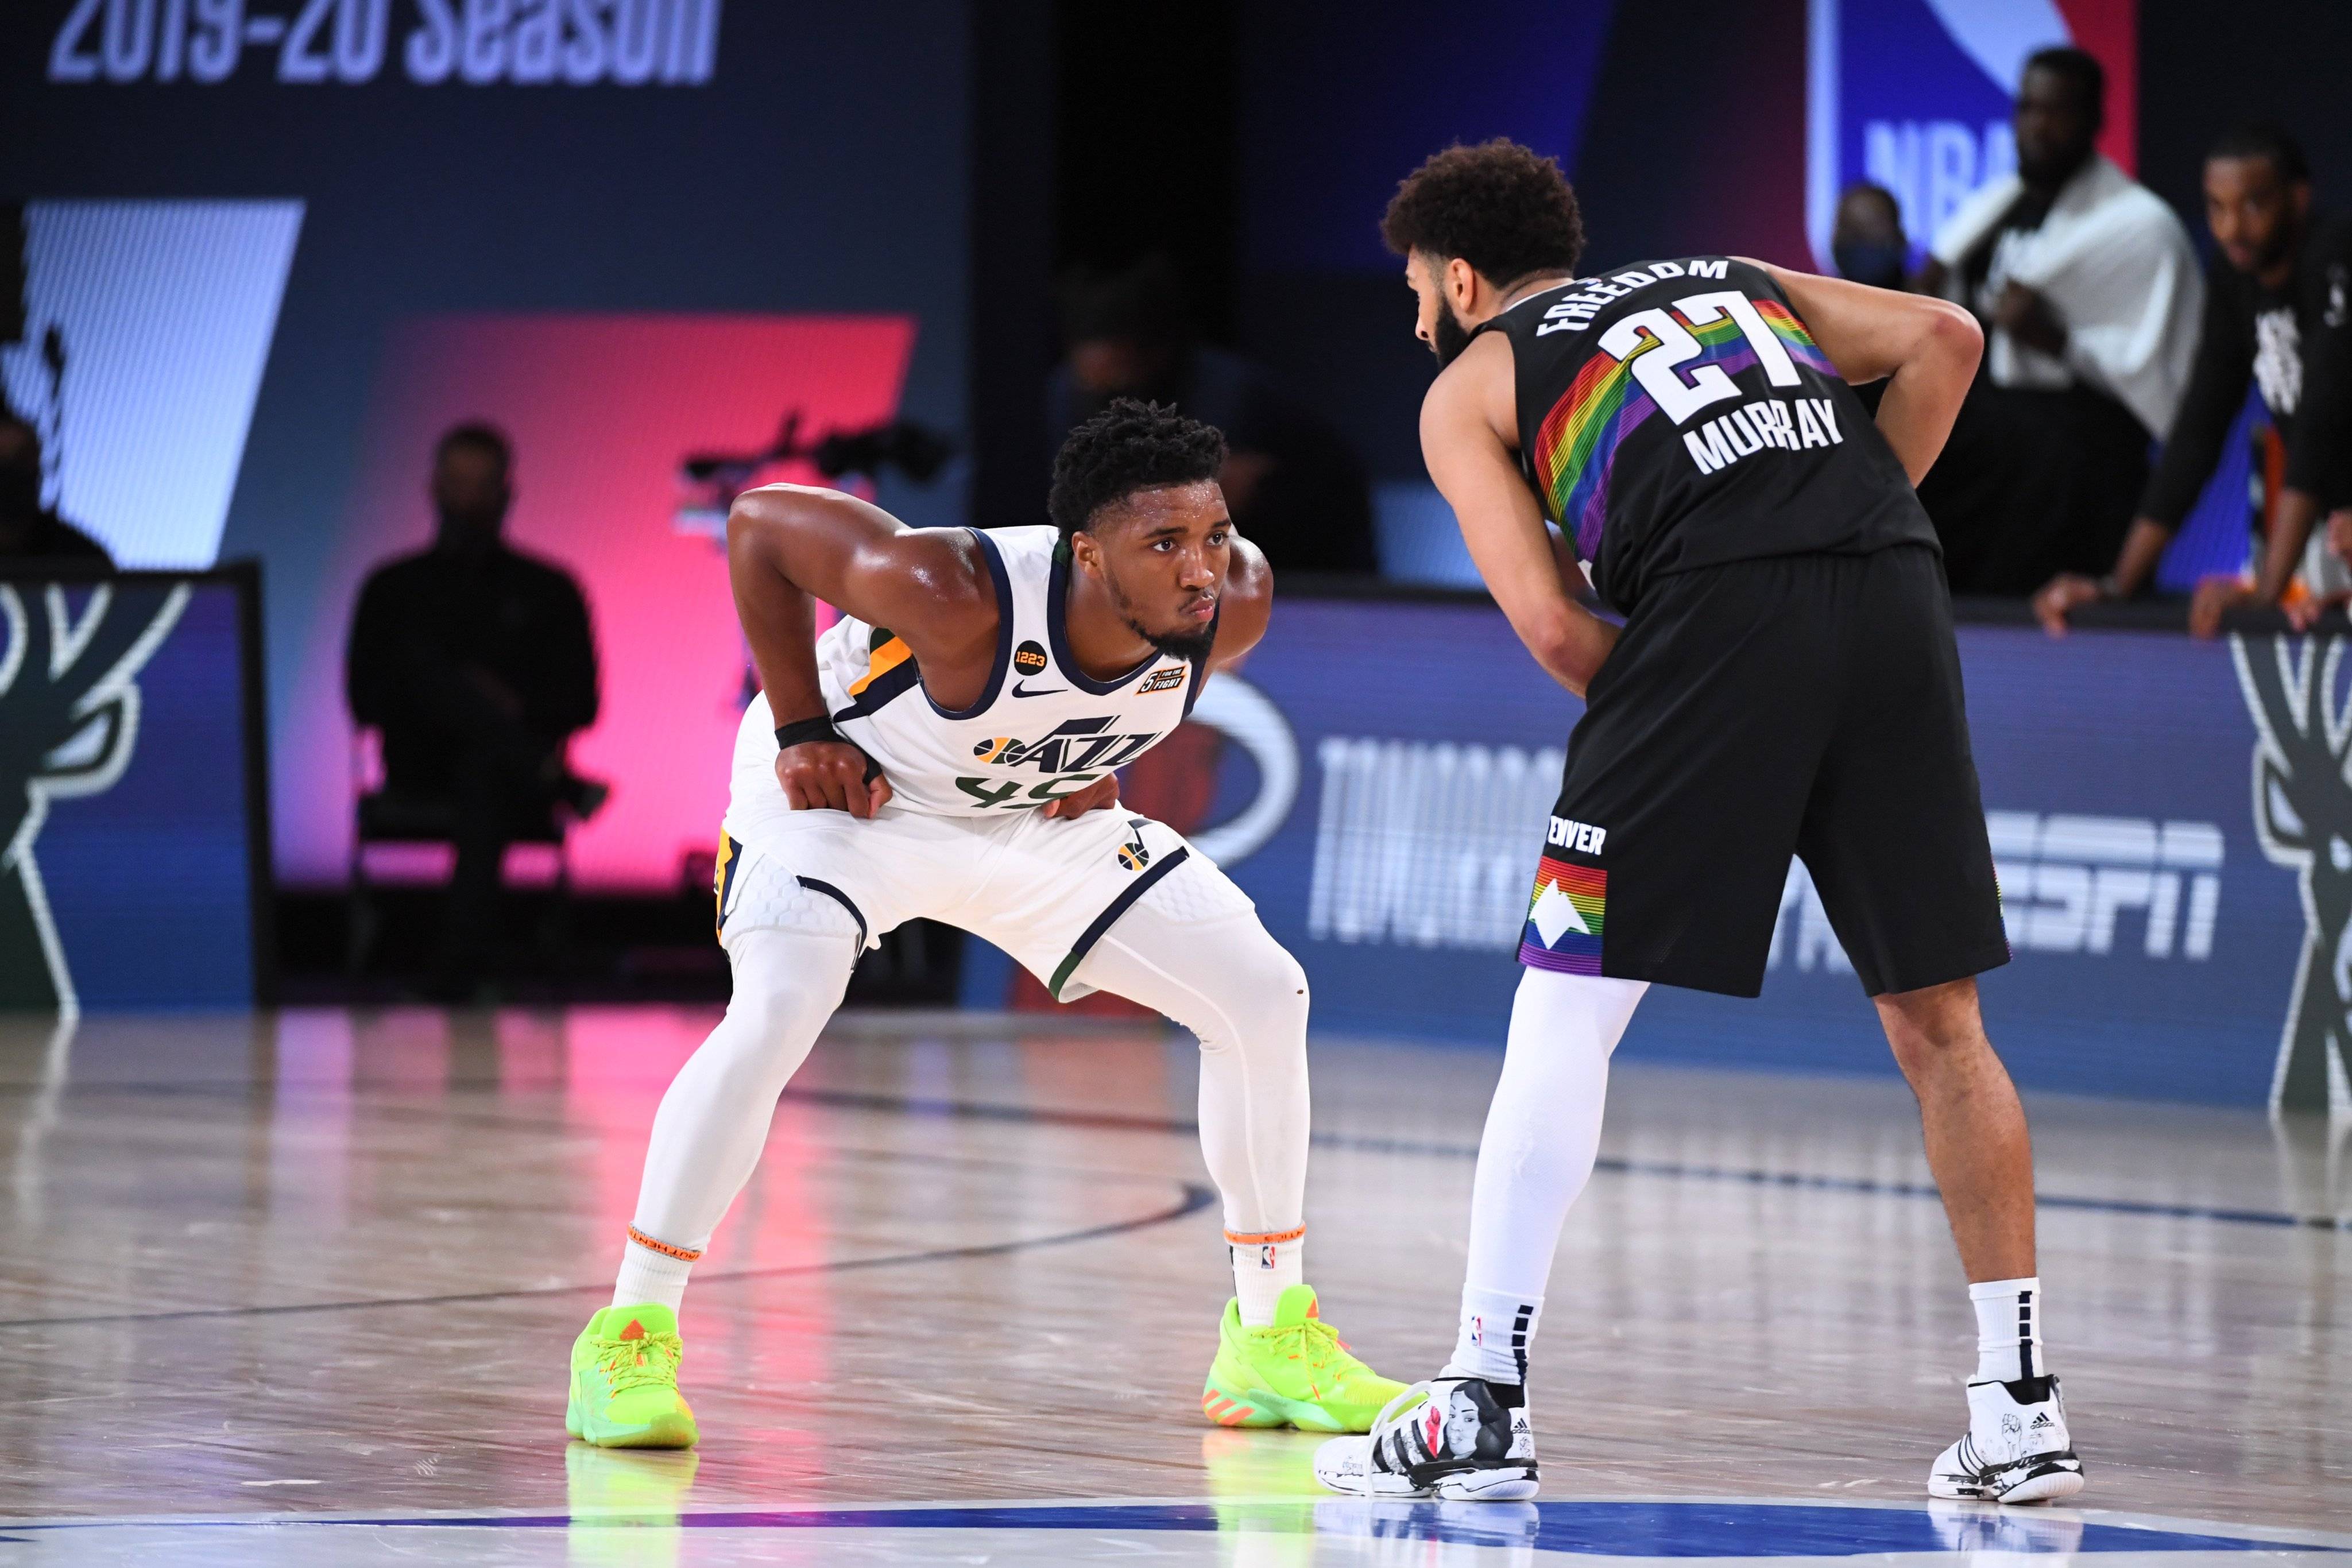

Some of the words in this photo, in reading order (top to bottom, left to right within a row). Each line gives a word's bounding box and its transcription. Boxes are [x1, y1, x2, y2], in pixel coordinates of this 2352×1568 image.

[48, 0, 392, 82] 2019-20
[404, 0, 721, 84] Season
[1536, 260, 1728, 336] FREEDOM
[1597, 291, 1801, 426] 27
[1682, 398, 1843, 475] MURRAY
[1016, 651, 1045, 667] 1223
[1140, 673, 1159, 692] 5
[1153, 677, 1182, 690] FIGHT
[974, 715, 1163, 774] JAZZ
[1548, 815, 1607, 855] ENVER
